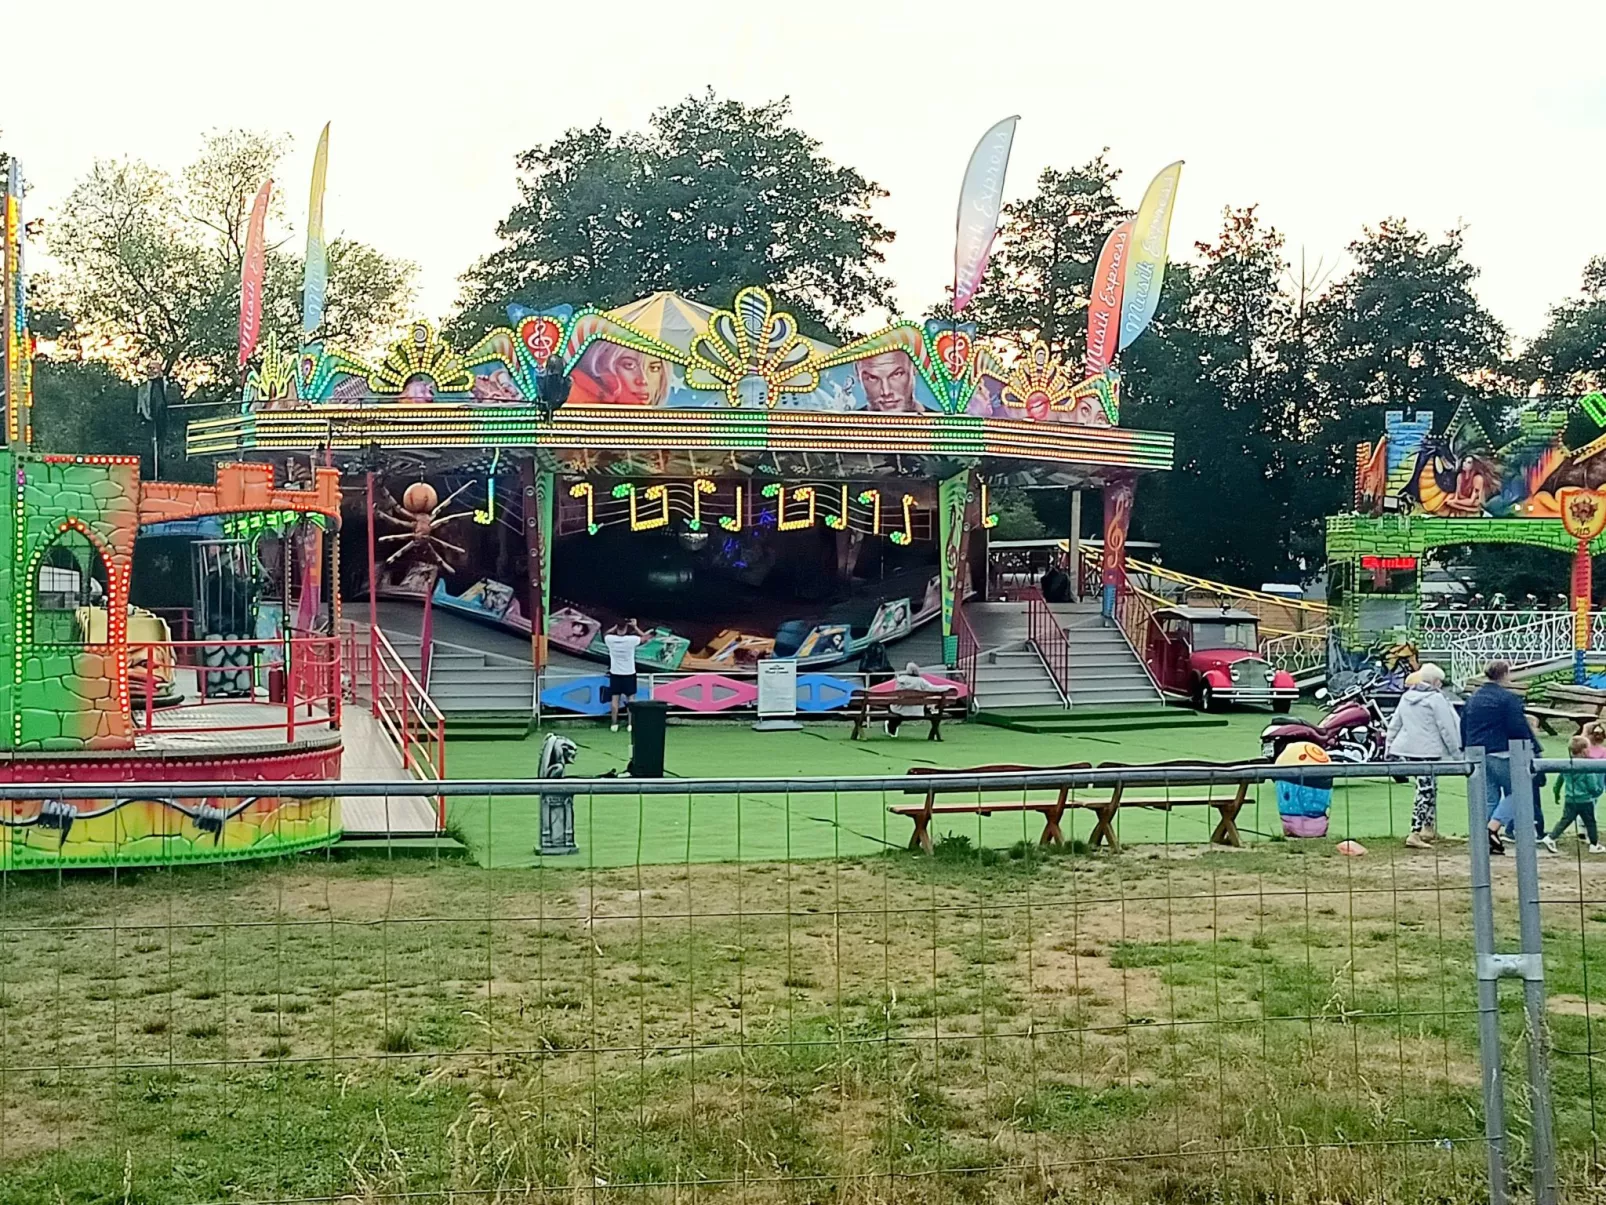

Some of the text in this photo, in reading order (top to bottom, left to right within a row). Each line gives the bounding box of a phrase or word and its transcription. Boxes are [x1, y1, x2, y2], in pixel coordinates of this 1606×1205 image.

[957, 131, 1008, 298] Musik Express
[1126, 175, 1174, 332] Musik Express
[241, 279, 256, 352] Musik
[1086, 232, 1127, 376] Musik Express
